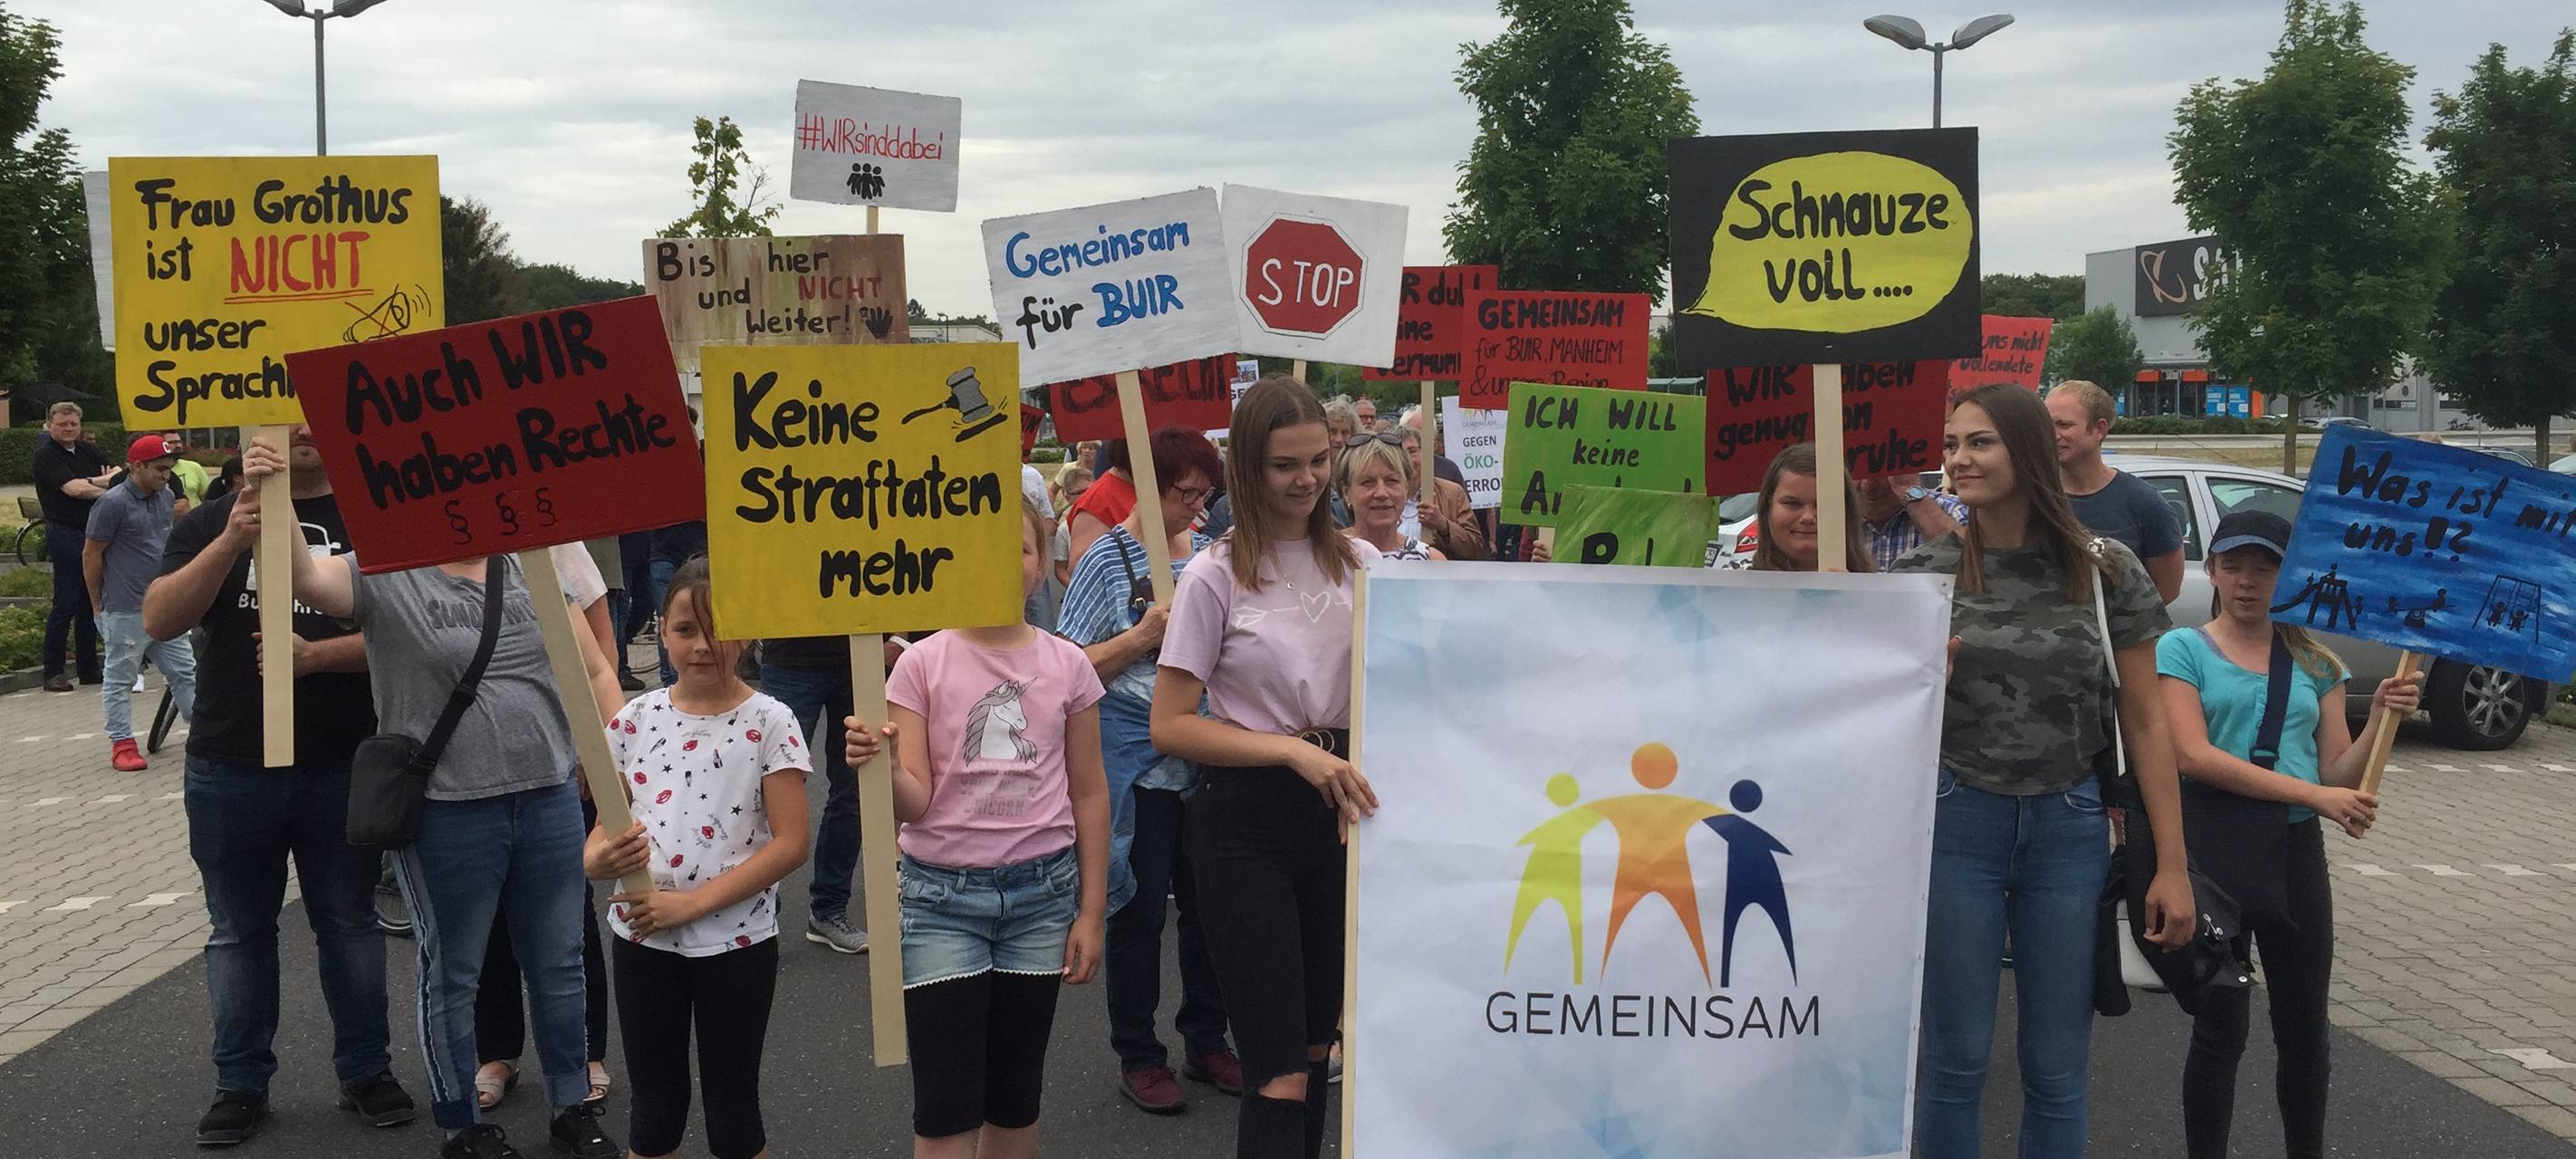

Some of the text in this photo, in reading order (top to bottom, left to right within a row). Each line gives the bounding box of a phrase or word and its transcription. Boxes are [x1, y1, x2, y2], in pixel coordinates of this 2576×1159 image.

[797, 113, 943, 160] #WIRsinddabei
[135, 174, 412, 230] Frau Grothus
[1728, 179, 1948, 240] Schnauze
[146, 231, 370, 293] ist NICHT
[657, 241, 829, 282] Bis hier
[1005, 222, 1189, 278] Gemeinsam
[698, 276, 882, 309] und NICHT
[1257, 257, 1355, 308] STOP
[1401, 271, 1480, 307] R dul
[745, 304, 850, 334] Weiter!
[1015, 274, 1185, 350] für BUIR
[1397, 315, 1433, 340] ine
[1477, 298, 1624, 330] GEMEINSAM
[144, 319, 266, 351] unser
[1475, 337, 1501, 362] für
[1550, 338, 1623, 364] MANHEIM
[345, 311, 608, 435] Auch WIR
[1841, 362, 1916, 392] aben
[733, 371, 879, 452] Keine
[1524, 395, 1677, 431] ICH WILL
[1842, 401, 1872, 431] on
[355, 393, 676, 511] haben Rechte
[1463, 436, 1497, 447] GEGEN
[1464, 453, 1498, 470] ÖKO-
[1572, 438, 1639, 467] keine
[1845, 427, 1928, 474] ruhe
[735, 455, 1002, 531] Straftaten
[1466, 477, 1503, 493] ERRO
[2338, 445, 2576, 538] Was ist mit
[820, 539, 954, 599] mehr
[1485, 991, 1820, 1039] GEMEINSAM
